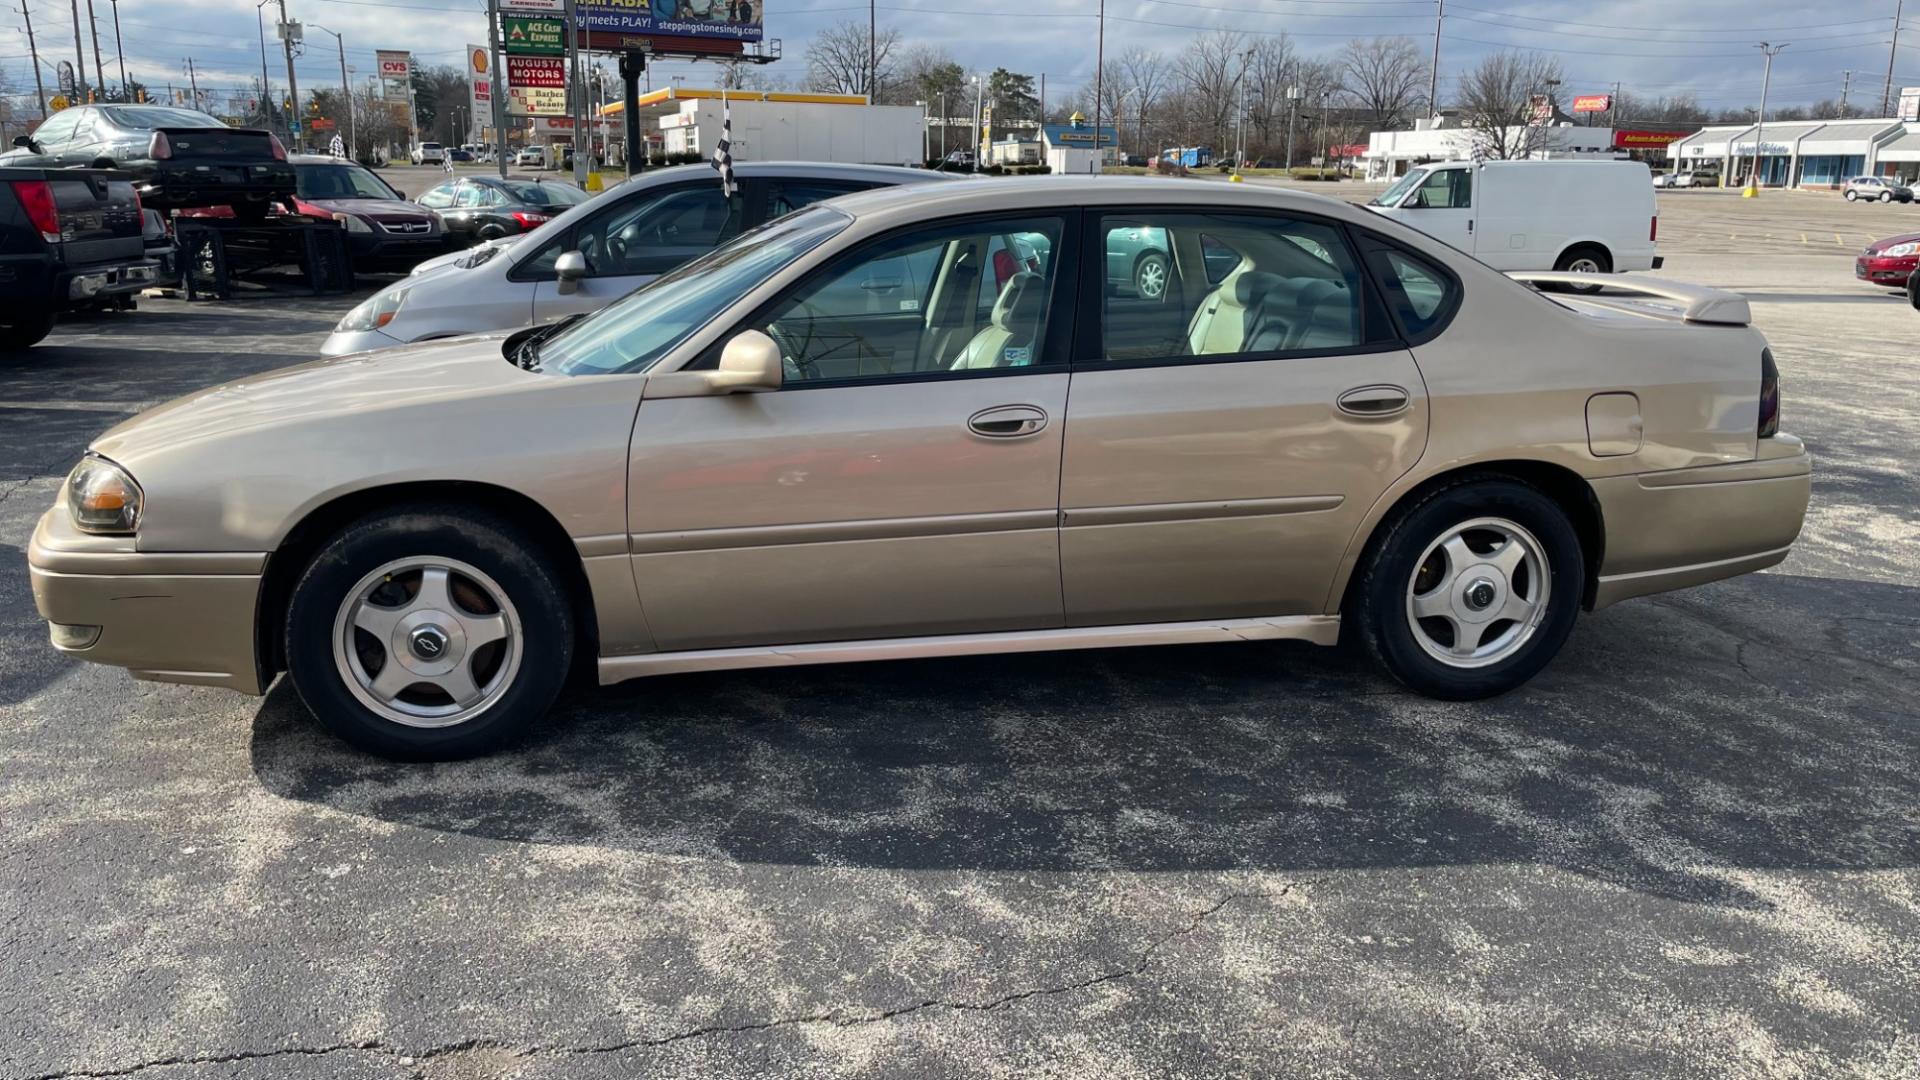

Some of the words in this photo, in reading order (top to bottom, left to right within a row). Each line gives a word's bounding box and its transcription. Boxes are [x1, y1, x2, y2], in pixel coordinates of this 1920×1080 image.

[527, 22, 543, 32] ACE
[587, 16, 619, 26] meets
[621, 17, 651, 28] PLAY!
[658, 21, 761, 37] steppingstonesindy.com
[383, 62, 407, 72] CVS
[510, 59, 562, 68] AUGUSTA
[513, 69, 560, 79] MOTORS
[536, 101, 564, 109] Beauty
